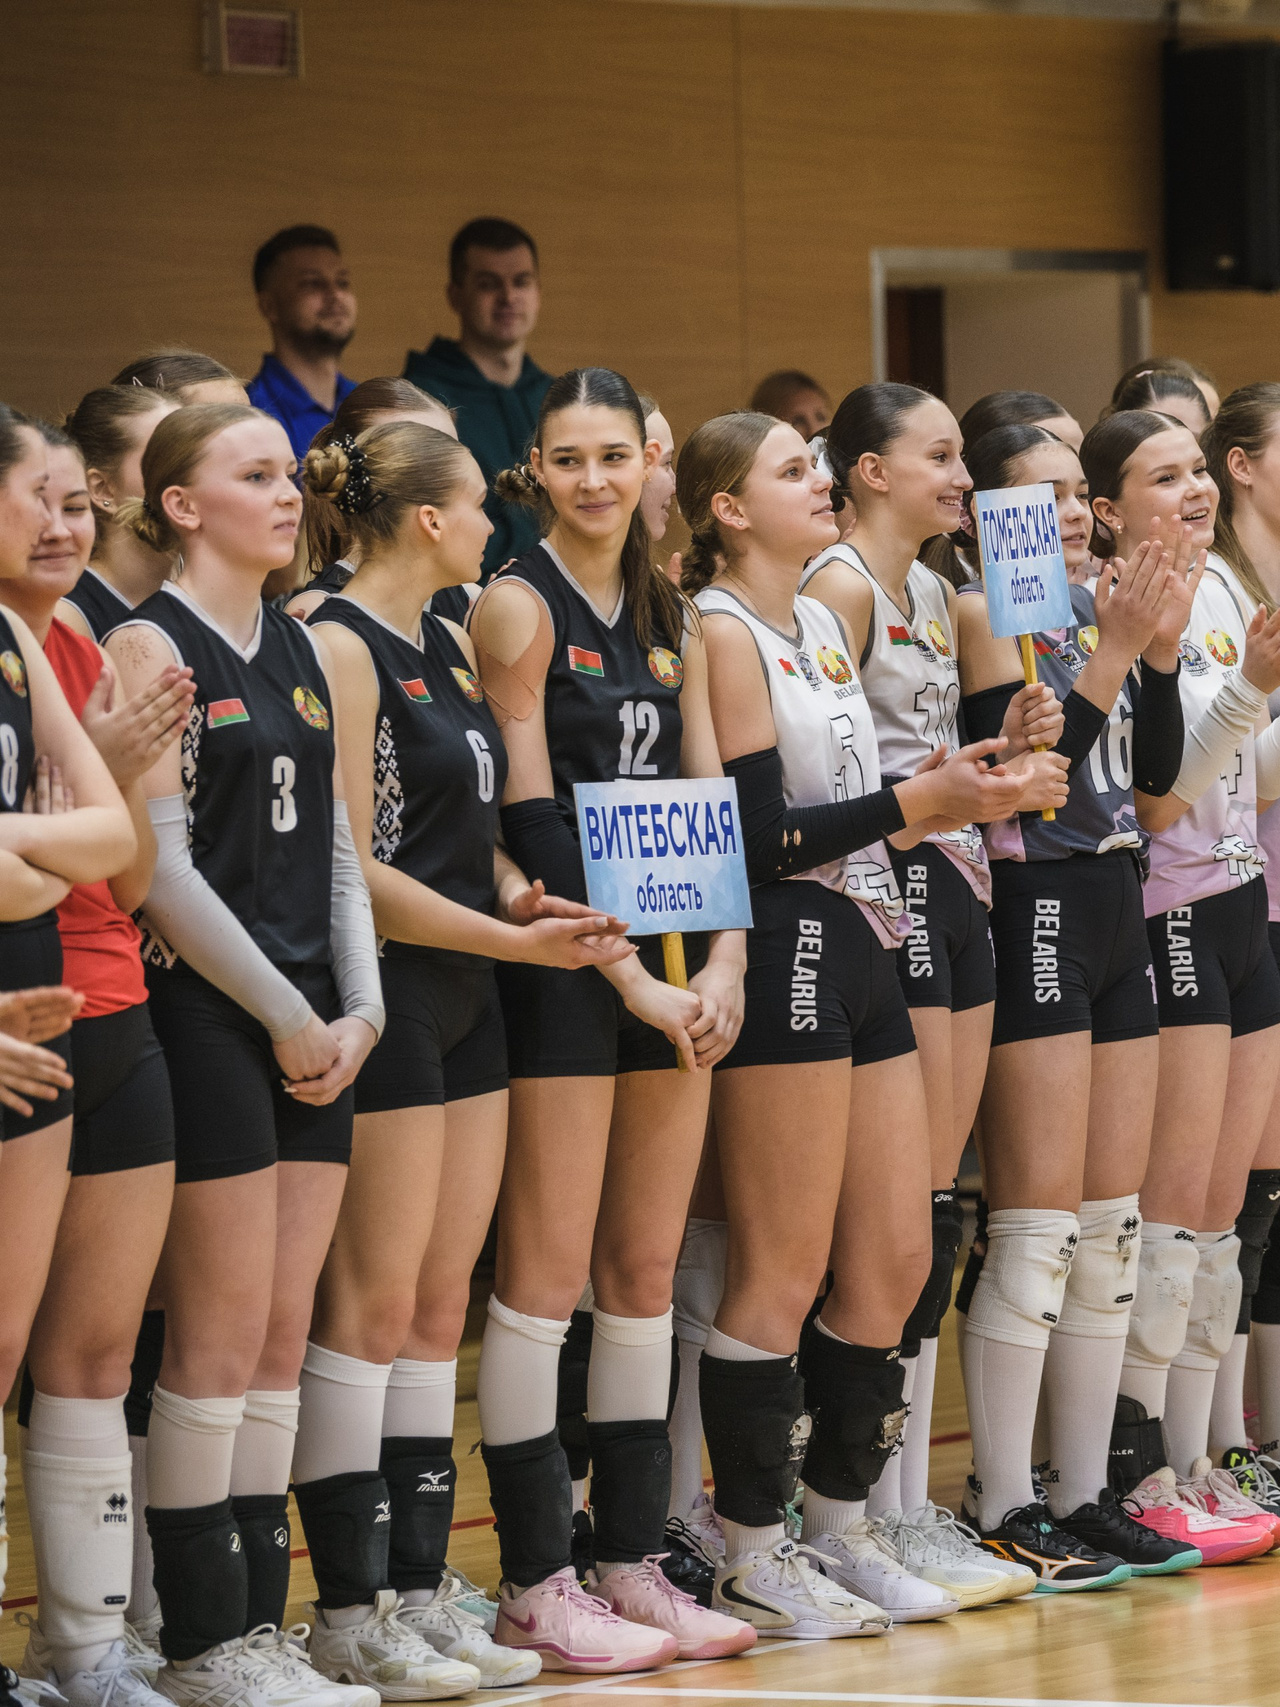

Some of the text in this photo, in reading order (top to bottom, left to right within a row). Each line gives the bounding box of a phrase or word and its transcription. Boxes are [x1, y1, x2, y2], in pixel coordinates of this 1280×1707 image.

[982, 502, 1060, 563] ГОМЕЛЬСКАЯ
[1011, 566, 1045, 605] область
[465, 729, 495, 803] 6
[619, 701, 660, 775] 12
[272, 756, 298, 833] 3
[584, 800, 738, 861] ВИТЕБСКАЯ
[636, 872, 704, 914] область
[790, 919, 823, 1032] BELARUS
[1032, 899, 1062, 1003] BELARUS
[1167, 905, 1199, 998] ELARUS
[780, 1543, 794, 1555] NIKE
